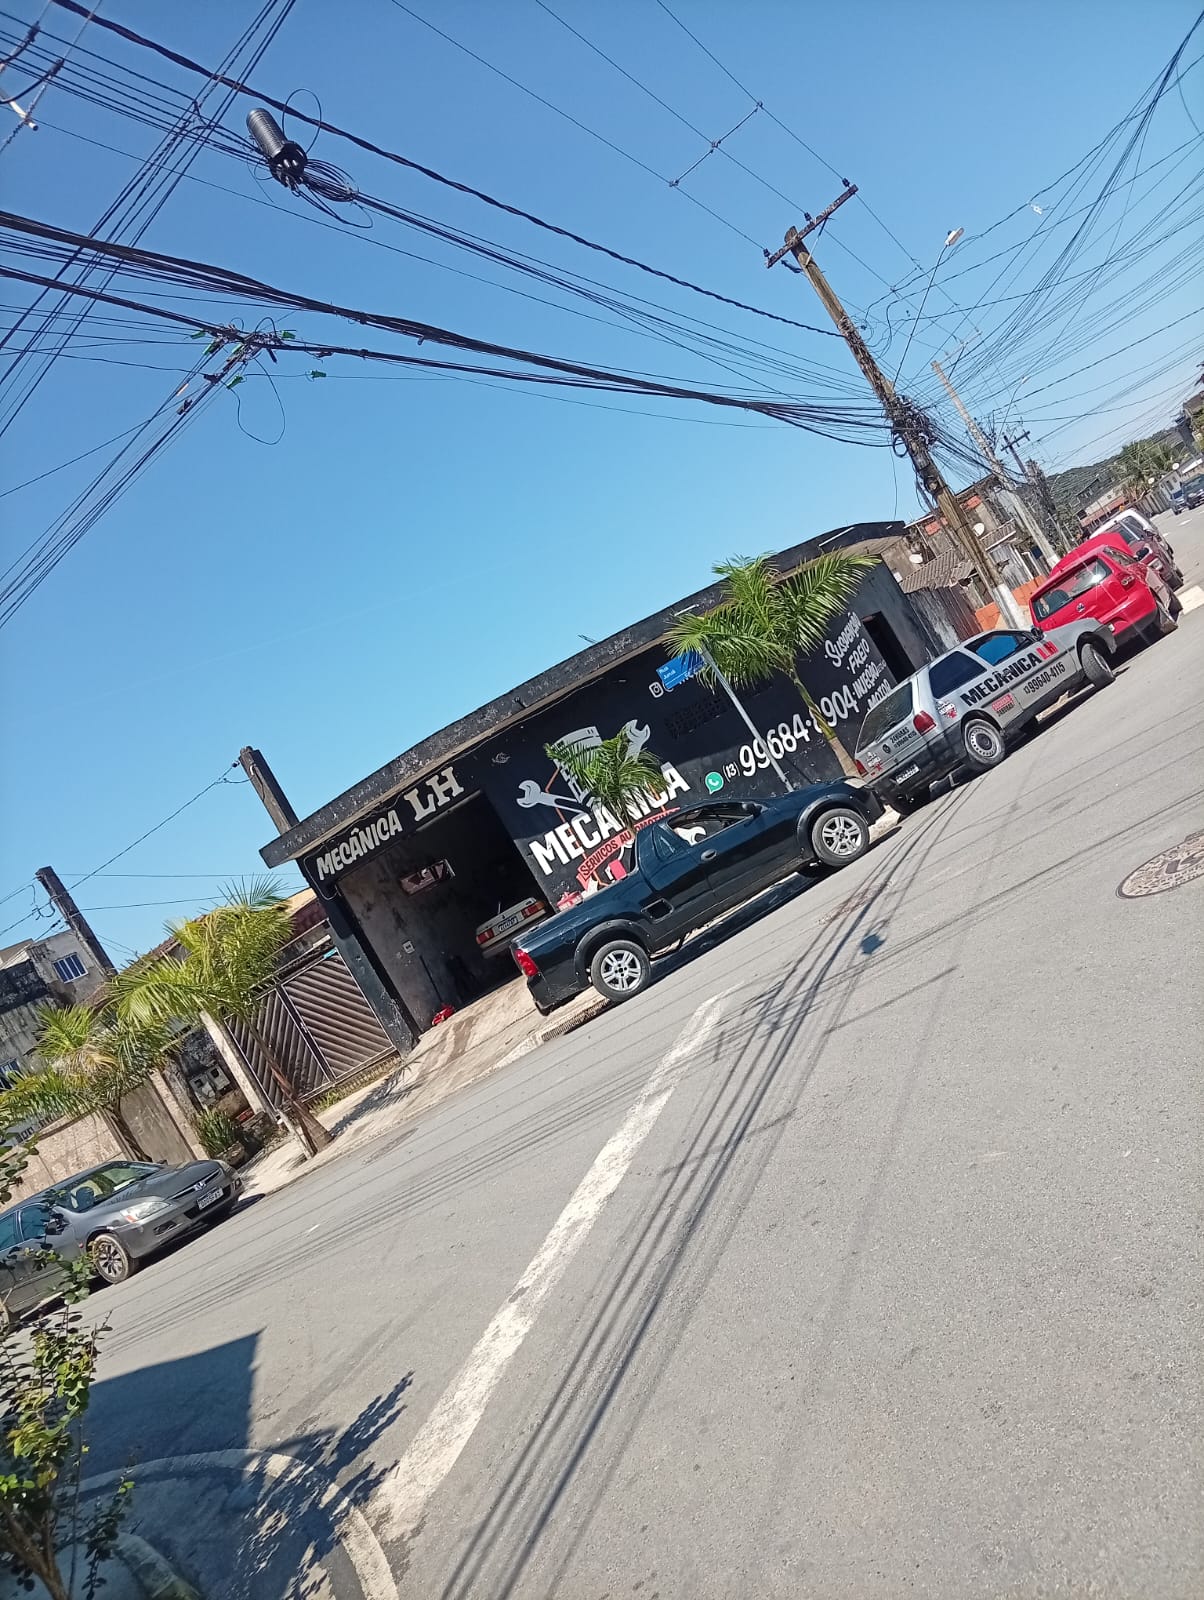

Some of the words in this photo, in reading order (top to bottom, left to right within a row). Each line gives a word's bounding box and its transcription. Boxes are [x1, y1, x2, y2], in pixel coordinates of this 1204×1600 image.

[848, 638, 870, 675] FREIO
[960, 652, 1042, 707] MECÂNICA
[1036, 640, 1059, 660] LH
[852, 661, 879, 699] INJEÇÃO
[868, 678, 891, 710] MOTOR
[1029, 662, 1066, 693] 99640-4115
[723, 762, 740, 783] (13)
[316, 810, 403, 881] MECÂNICA
[404, 766, 464, 822] LH
